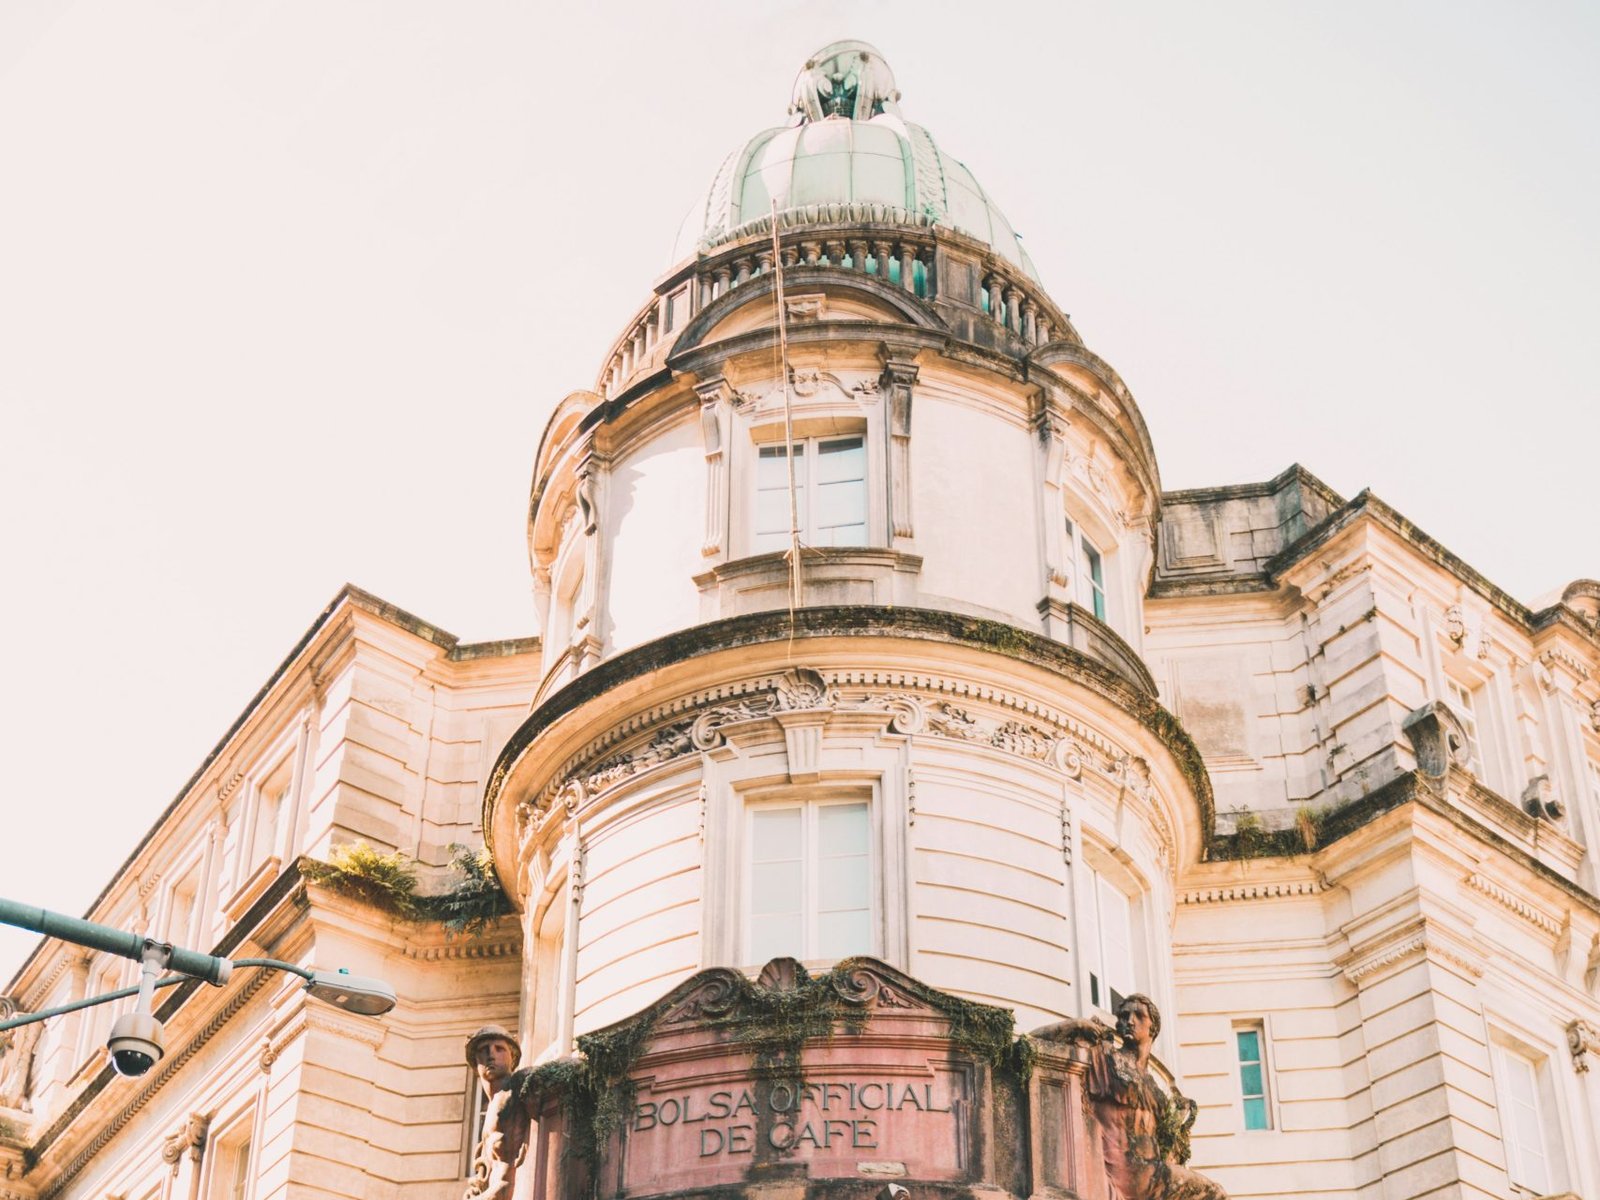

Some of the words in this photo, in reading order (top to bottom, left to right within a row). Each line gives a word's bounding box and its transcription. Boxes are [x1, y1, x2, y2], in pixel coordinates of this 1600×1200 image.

[634, 1089, 760, 1132] BOLSA
[769, 1082, 952, 1113] OFFICIAL
[700, 1125, 753, 1157] DE
